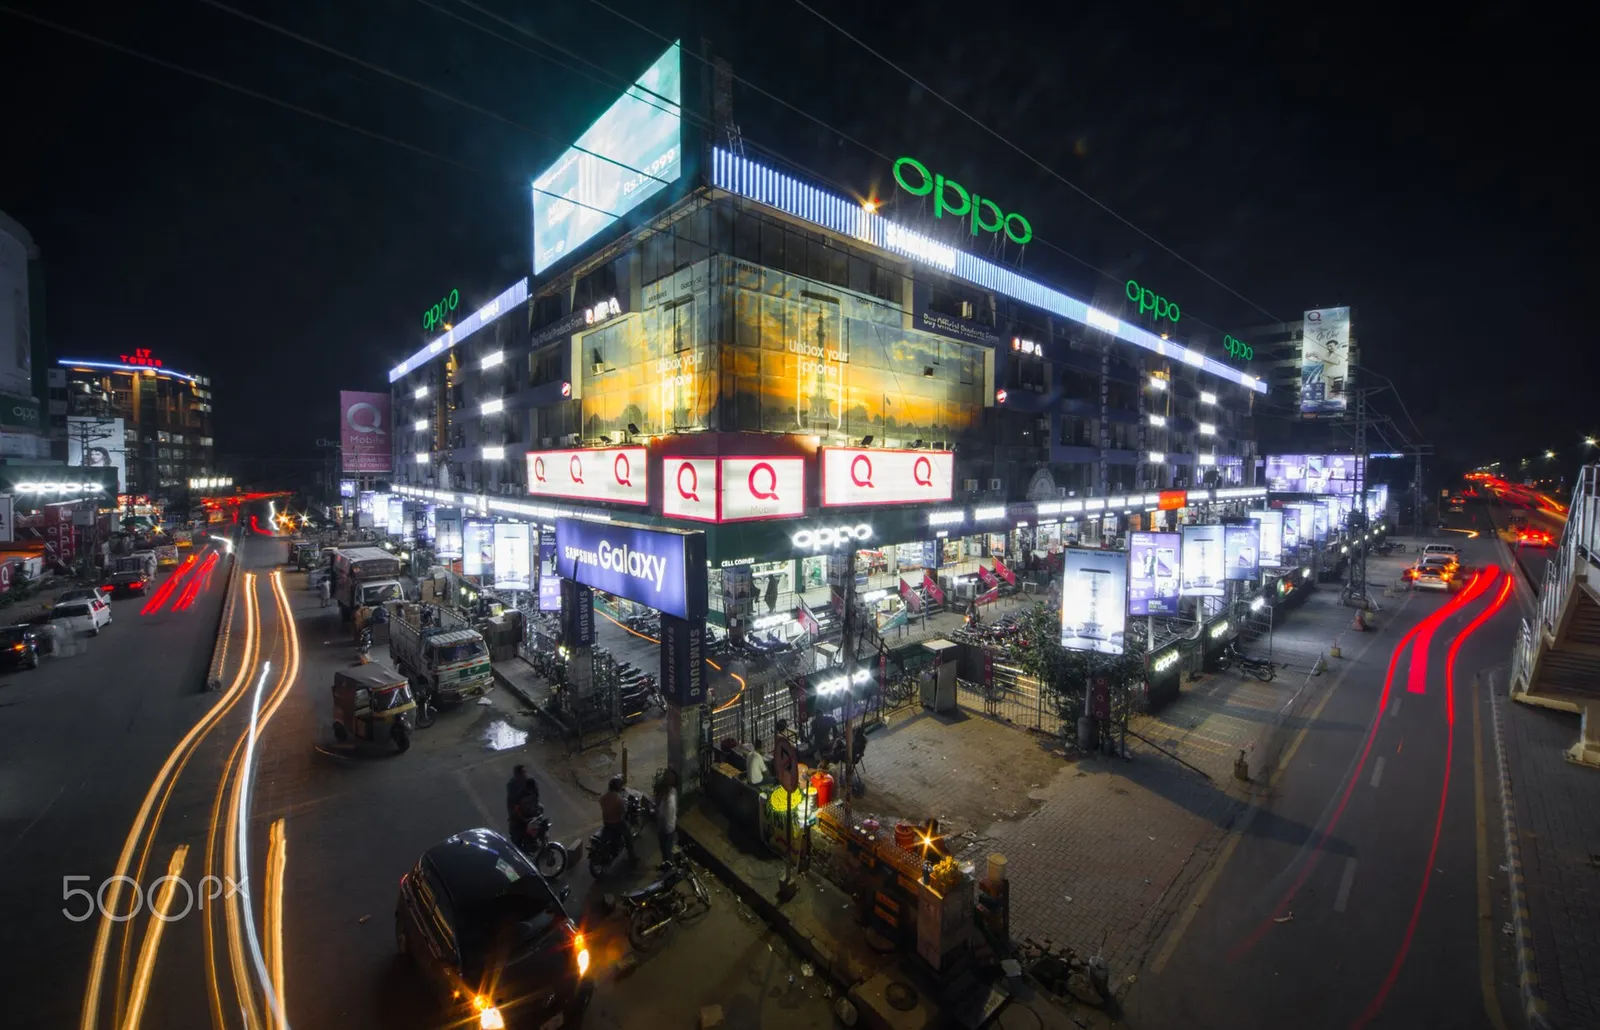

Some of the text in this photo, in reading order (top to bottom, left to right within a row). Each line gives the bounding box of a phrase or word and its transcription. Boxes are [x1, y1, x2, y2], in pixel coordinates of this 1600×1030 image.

[893, 157, 1032, 244] oppo
[423, 288, 459, 332] oppo
[1126, 280, 1180, 322] oppo
[683, 351, 704, 371] your
[789, 340, 850, 362] Unbox your
[1224, 334, 1253, 360] oppo
[802, 360, 837, 376] phone
[347, 402, 386, 435] Q
[350, 435, 385, 445] Mobile
[565, 540, 666, 592] SAMSUNG Galaxy
[580, 590, 590, 641] SAMSUNG
[690, 628, 700, 697] SAMSUNG
